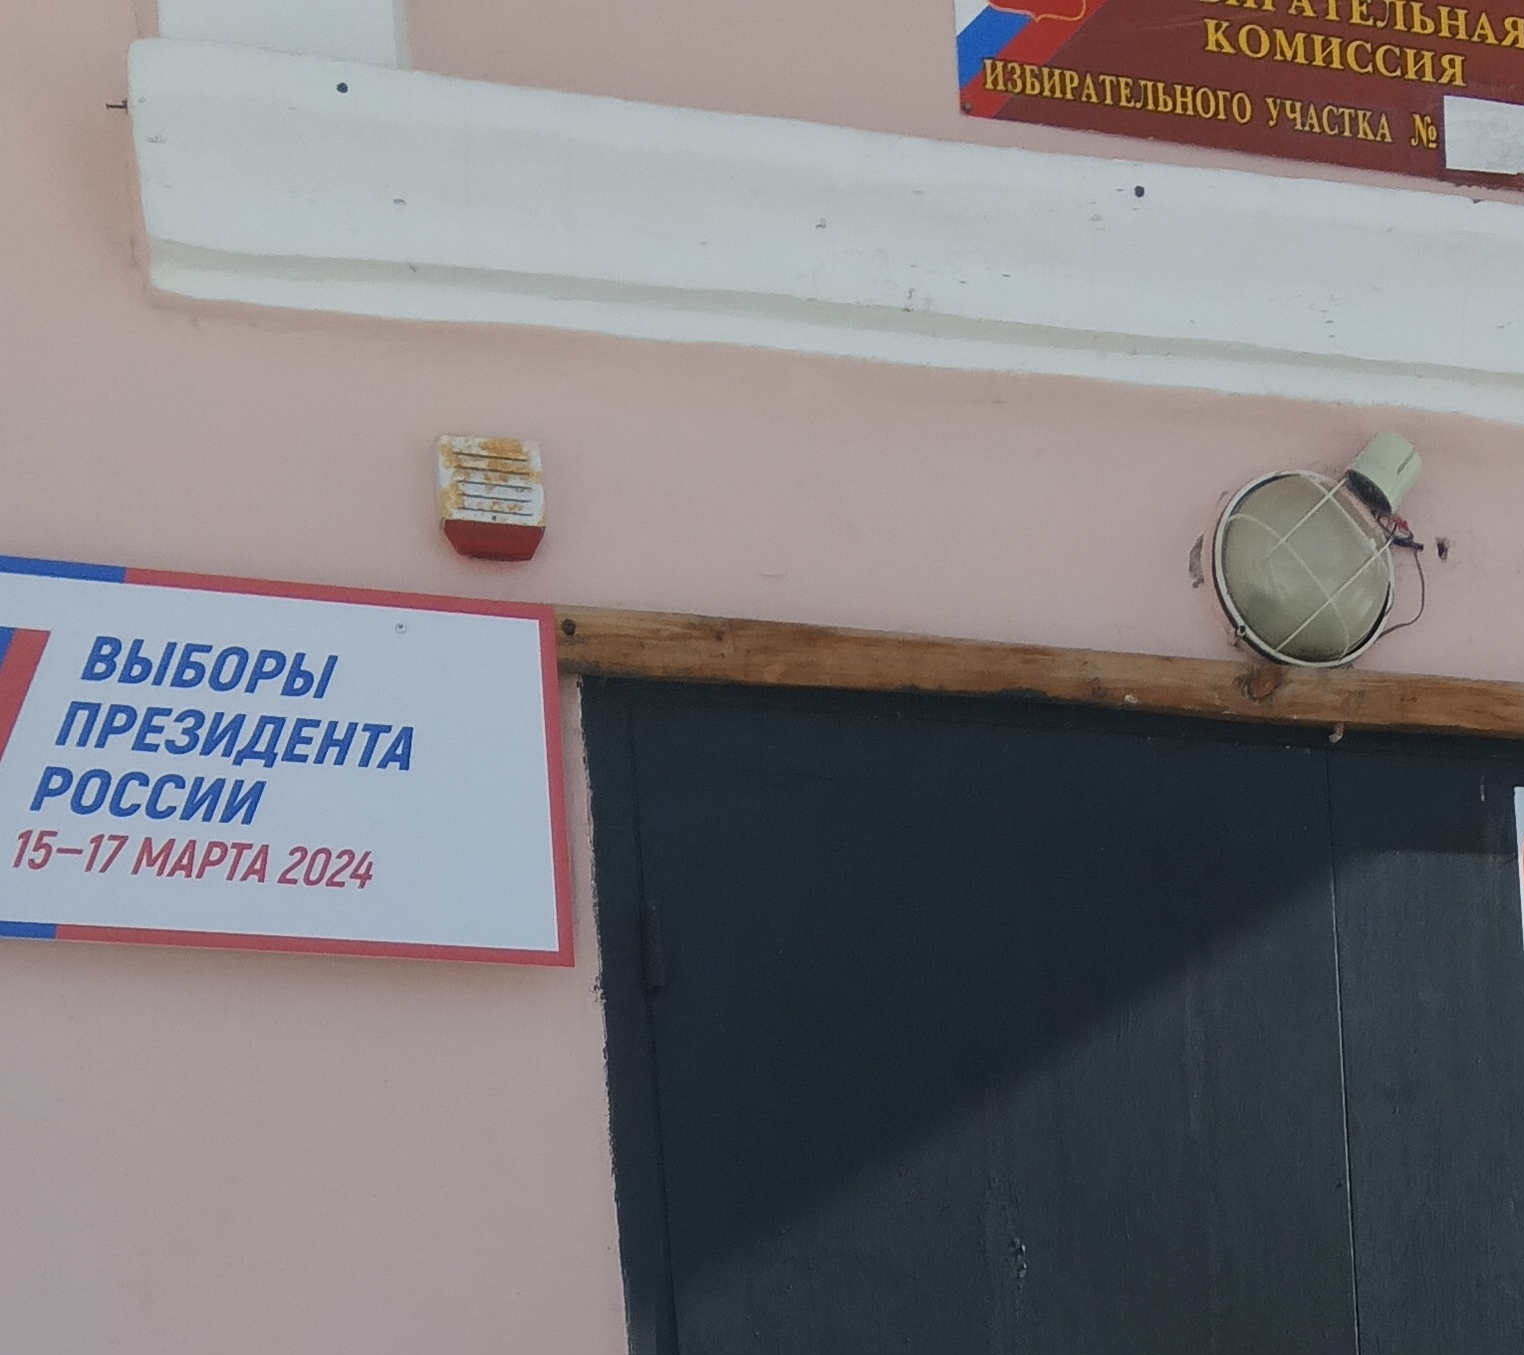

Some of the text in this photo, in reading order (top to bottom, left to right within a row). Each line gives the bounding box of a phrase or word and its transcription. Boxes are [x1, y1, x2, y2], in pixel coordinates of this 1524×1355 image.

[1203, 18, 1467, 87] КОМИССИЯ
[983, 59, 1438, 150] ИЗБИРАТЕЛЬНОГО УЧАСТКА №
[80, 635, 339, 700] ВЫБОРЫ
[54, 700, 415, 771] ПРЕЗИДЕНТА
[29, 765, 267, 826] РОССИИ
[12, 829, 375, 889] 15–17 МАРТА 2024
